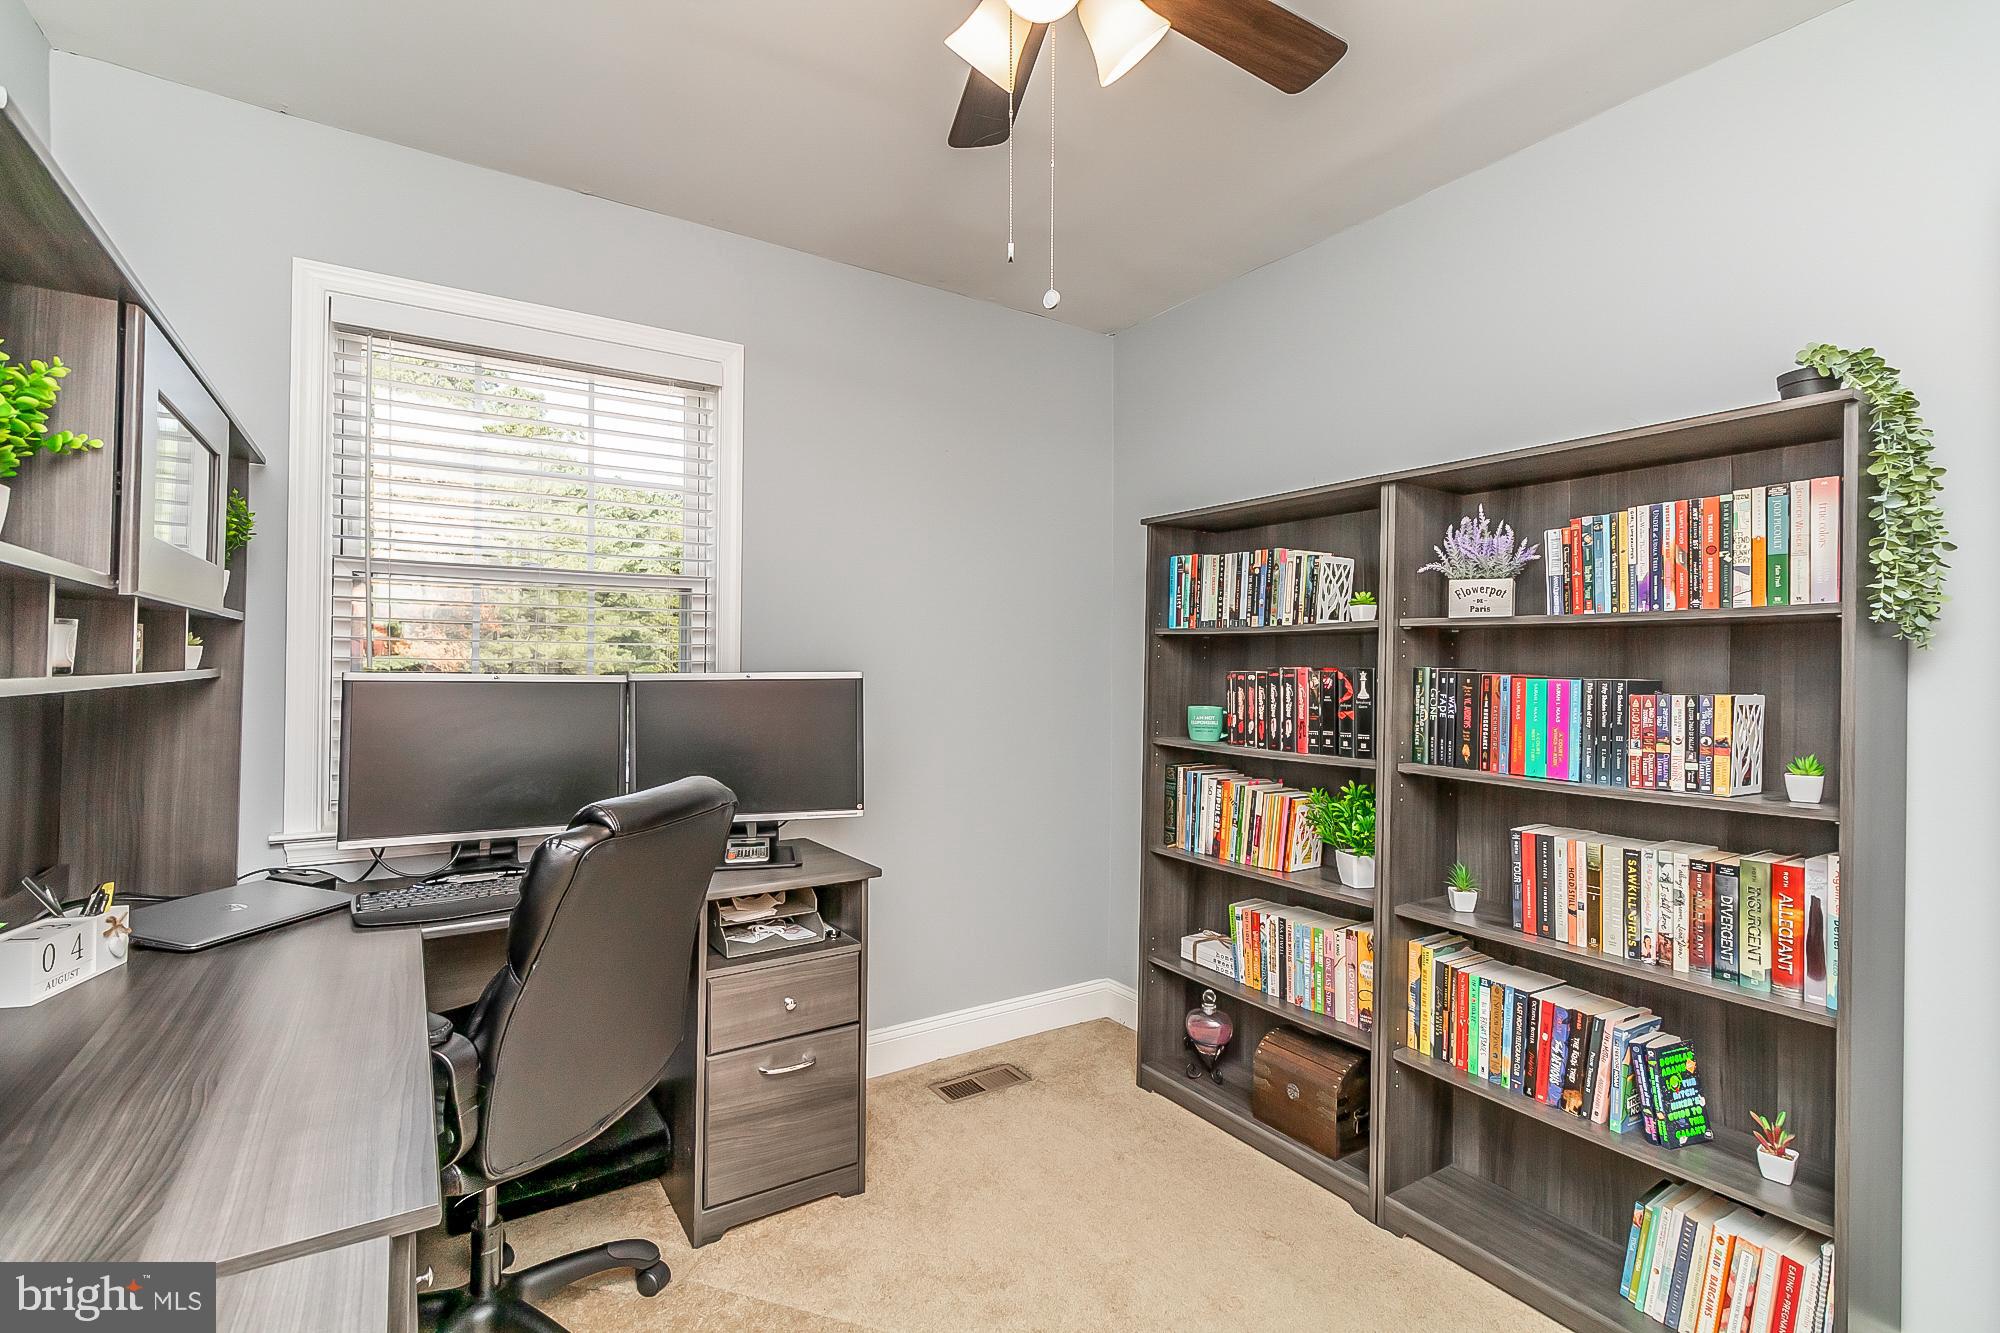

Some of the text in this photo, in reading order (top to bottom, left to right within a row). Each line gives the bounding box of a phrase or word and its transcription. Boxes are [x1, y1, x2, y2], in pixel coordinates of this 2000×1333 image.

[1772, 500, 1782, 550] JODI PICOULT
[1455, 586, 1508, 600] Flowerpot
[1430, 688, 1440, 720] GONE
[1438, 694, 1447, 718] FADE
[1632, 708, 1640, 740] CLUB DEAD
[1628, 859, 1638, 947] SAWKILL GIRLS
[1660, 894, 1673, 930] still love
[1675, 869, 1687, 959] always Lara Jean
[1692, 890, 1705, 960] ALLEGIANT
[1720, 895, 1734, 965] DIVERGENT
[1747, 886, 1762, 966] INSURGENT
[1778, 892, 1794, 975] ALLEGIANT
[42, 943, 56, 973] 0
[71, 933, 84, 961] 4
[1213, 958, 1234, 970] sweet
[1216, 952, 1234, 963] home
[45, 968, 80, 991] AUGUST
[1215, 964, 1234, 976] home
[1480, 1017, 1488, 1056] BRIGHT PLACES
[1493, 1031, 1501, 1050] BONE
[1514, 1034, 1523, 1063] TELEGRAPH
[1572, 1038, 1581, 1050] THE
[1550, 1054, 1562, 1087] DEVIOUS
[1660, 1051, 1694, 1067] DOUGLAS
[1661, 1063, 1687, 1077] ADAMS
[1673, 1087, 1699, 1100] HITCH-
[1682, 1077, 1697, 1088] THE
[1668, 1105, 1703, 1122] GUIDE TO
[1689, 1115, 1706, 1126] THE
[1676, 1124, 1707, 1139] GALAXY
[1705, 1249, 1723, 1319] BABY BARGAINS
[1785, 1265, 1797, 1292] EATING
